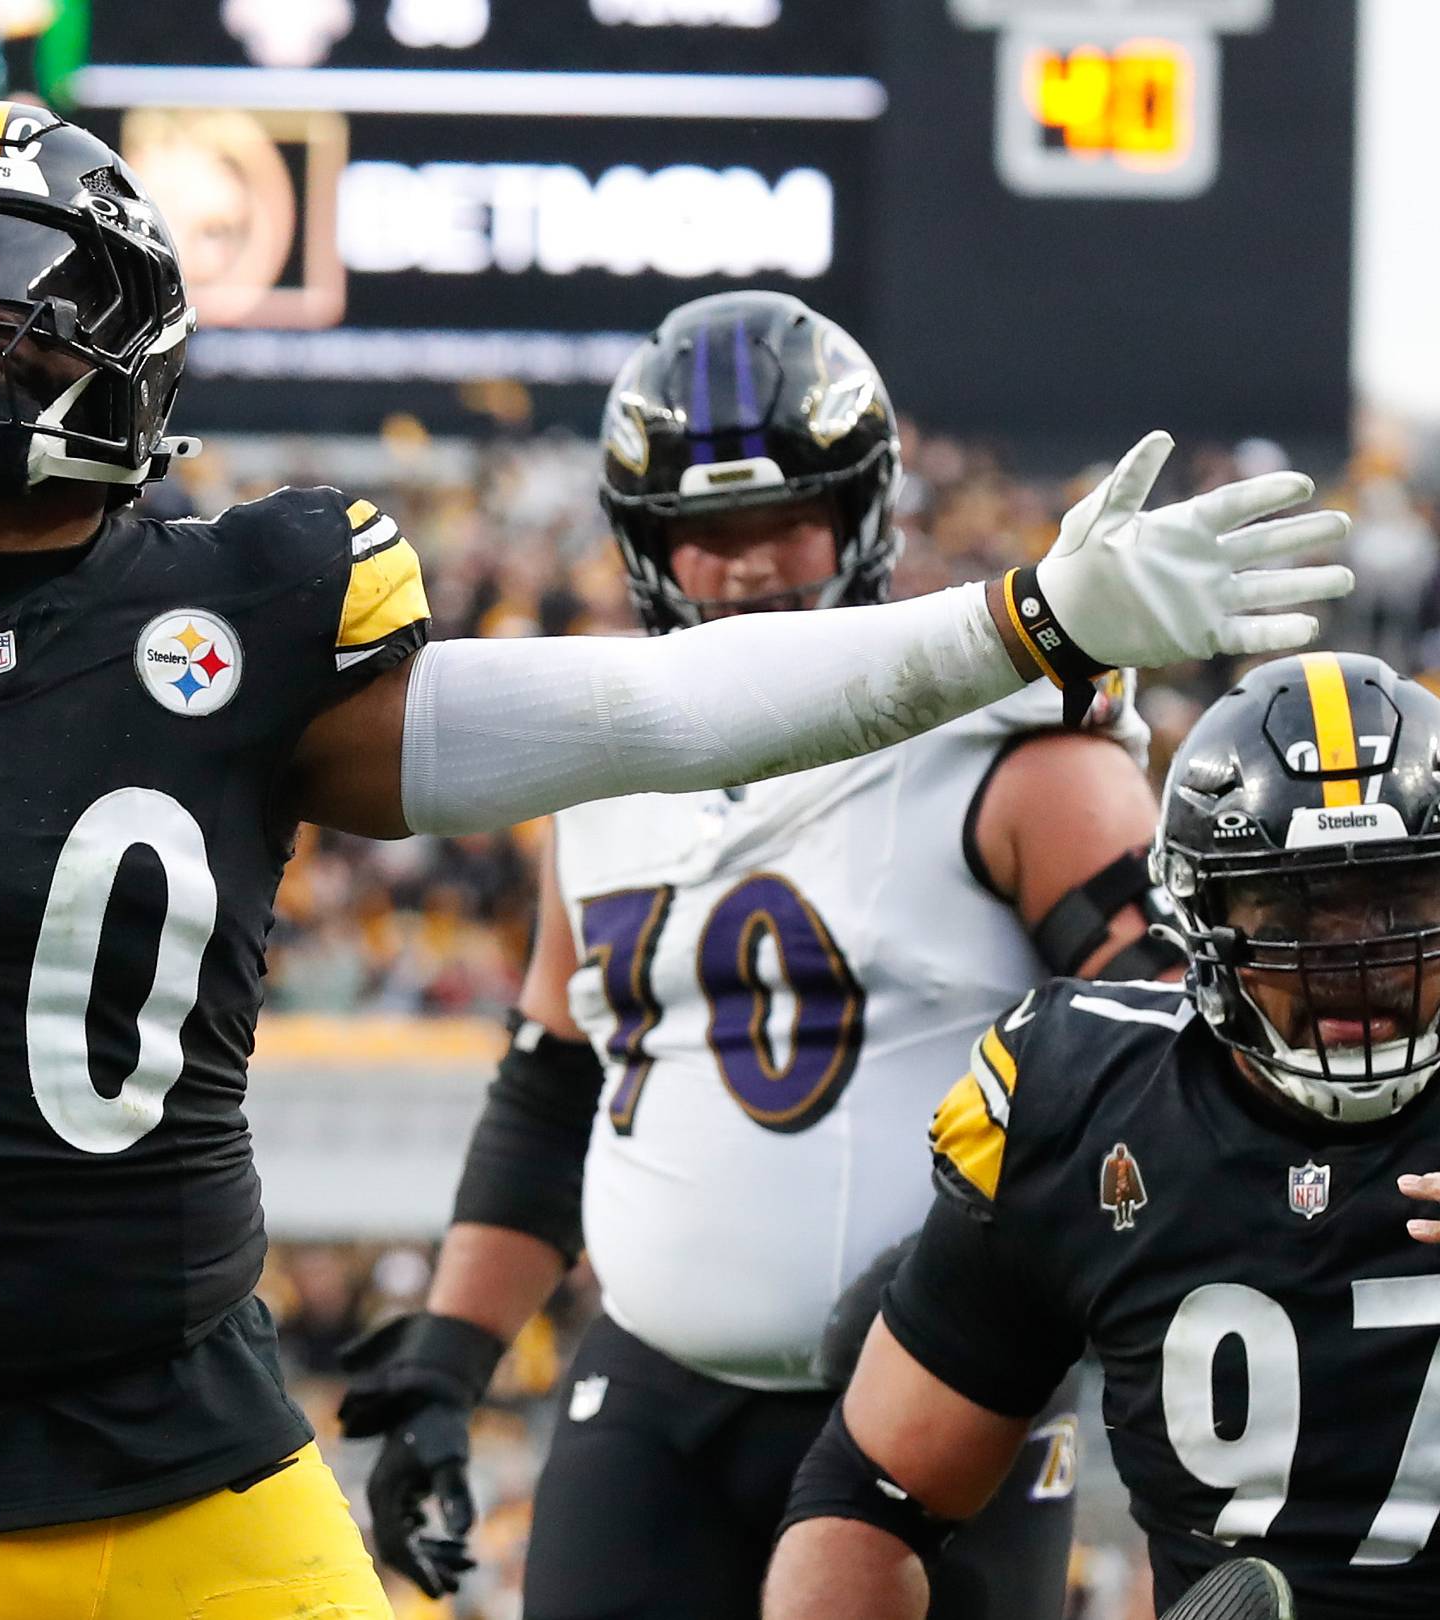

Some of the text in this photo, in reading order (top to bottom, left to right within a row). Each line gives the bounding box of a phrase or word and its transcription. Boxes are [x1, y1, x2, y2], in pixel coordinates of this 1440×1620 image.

[1036, 627, 1061, 651] 22
[147, 649, 187, 666] Steelers
[1318, 811, 1378, 830] Steelers
[1213, 827, 1257, 839] OAKLEY
[576, 872, 866, 1136] 70
[1295, 1186, 1323, 1207] NFL
[1162, 1275, 1440, 1567] 97
